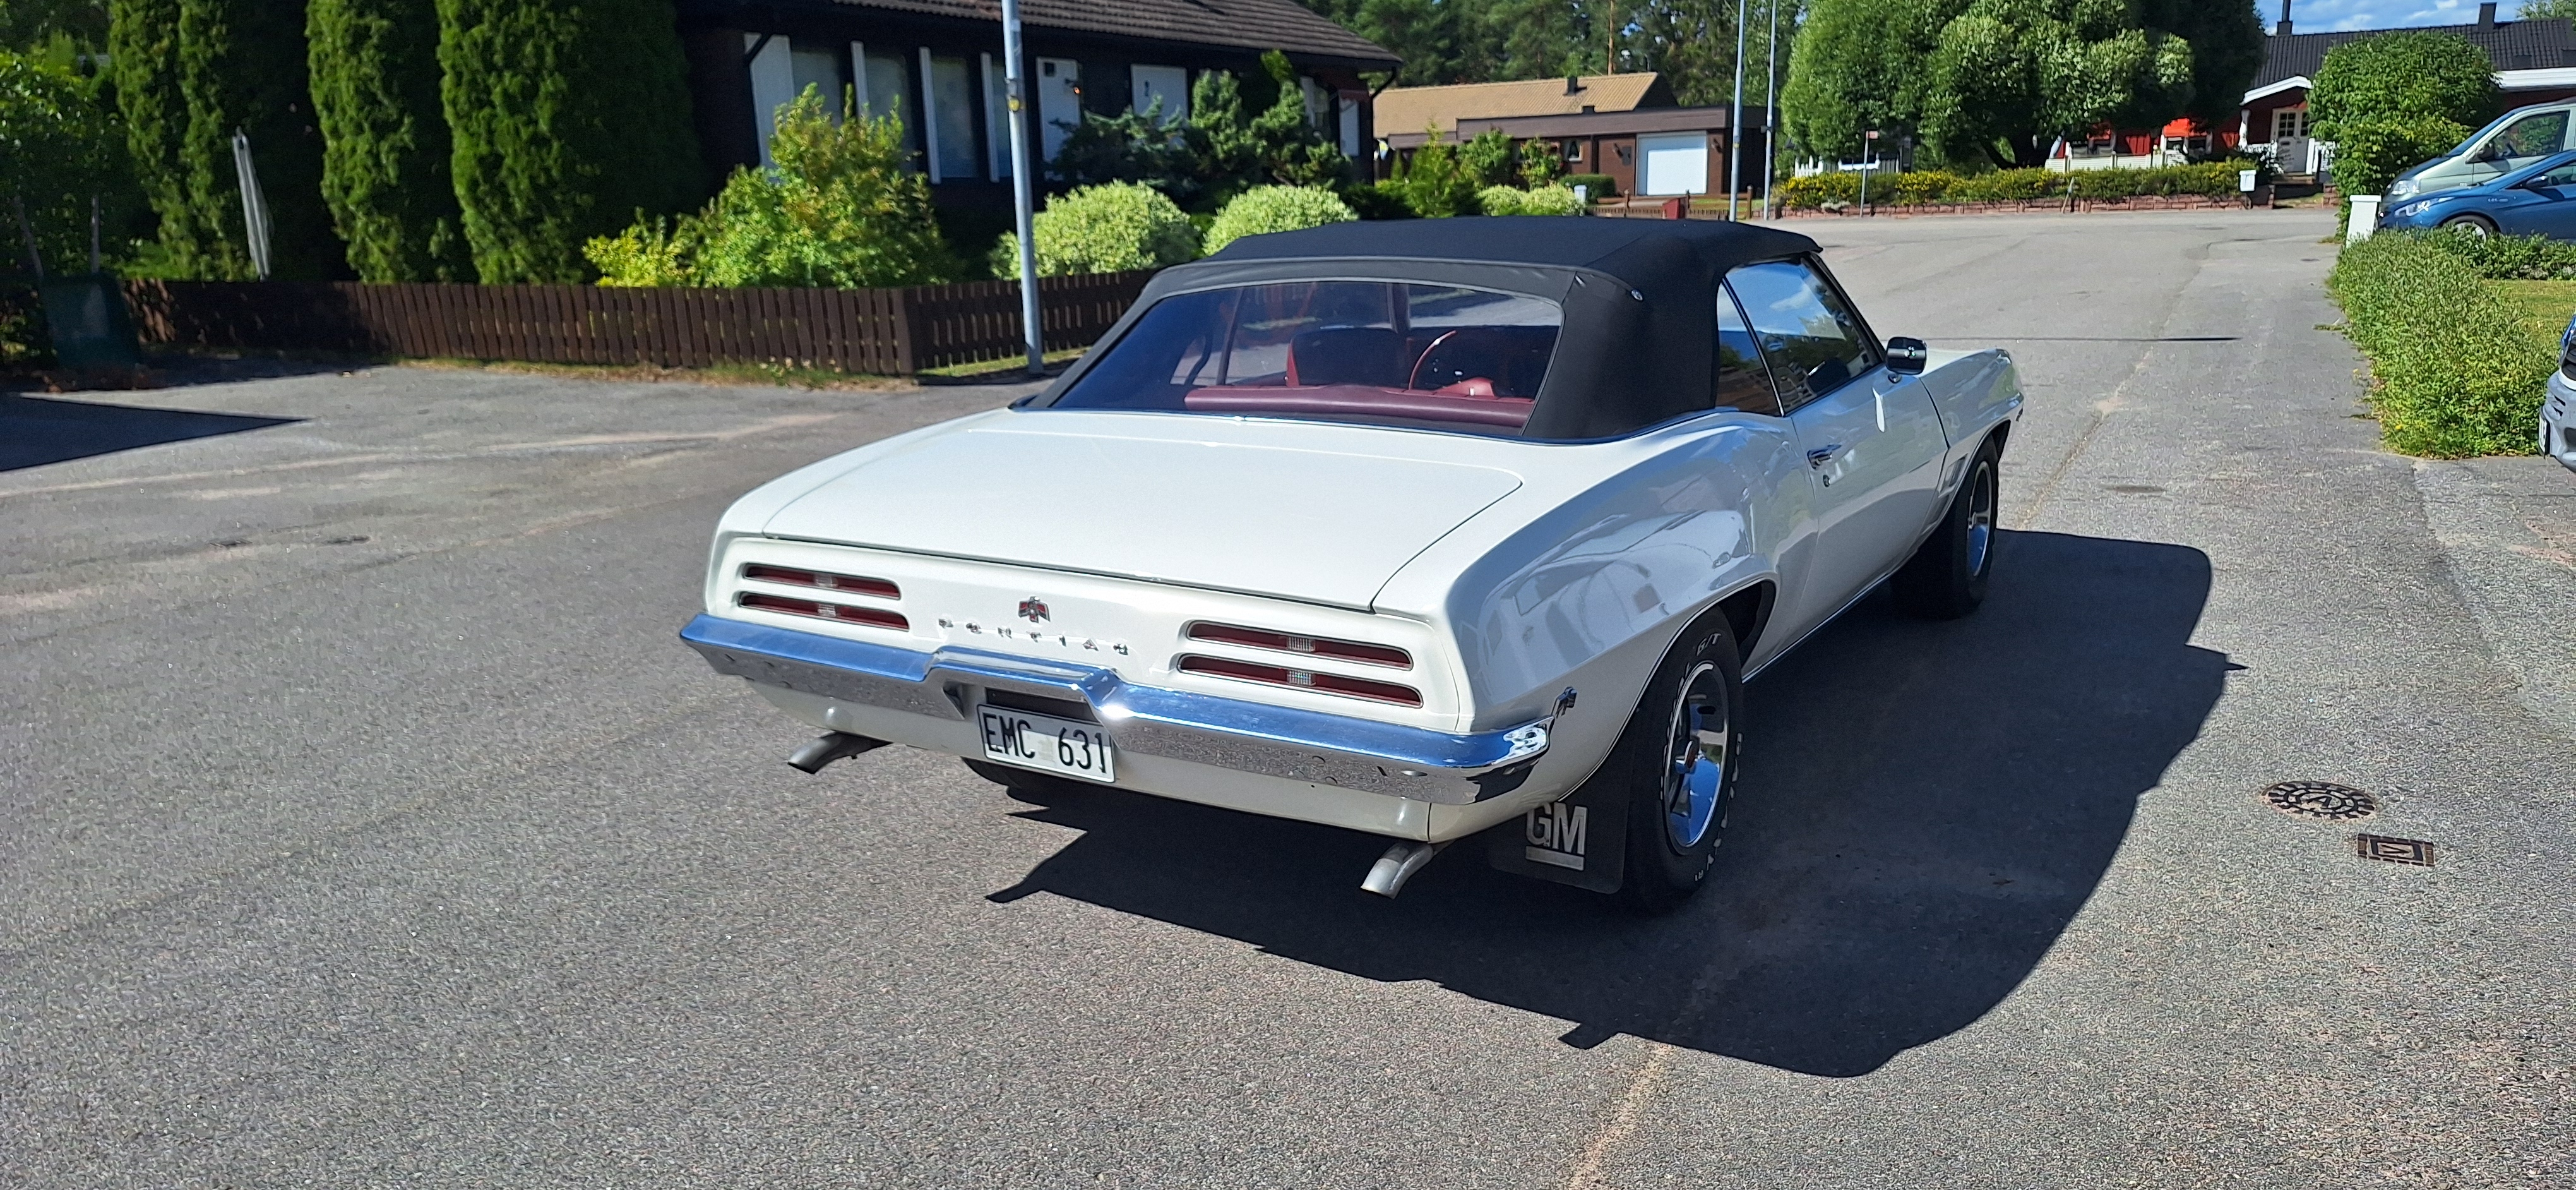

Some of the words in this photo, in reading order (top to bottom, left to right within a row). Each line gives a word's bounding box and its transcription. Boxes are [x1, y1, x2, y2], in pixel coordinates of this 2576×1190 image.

[938, 618, 1129, 656] PONTIAC
[983, 712, 1035, 759] EMC
[1058, 727, 1106, 774] 631
[1526, 802, 1587, 855] GM
